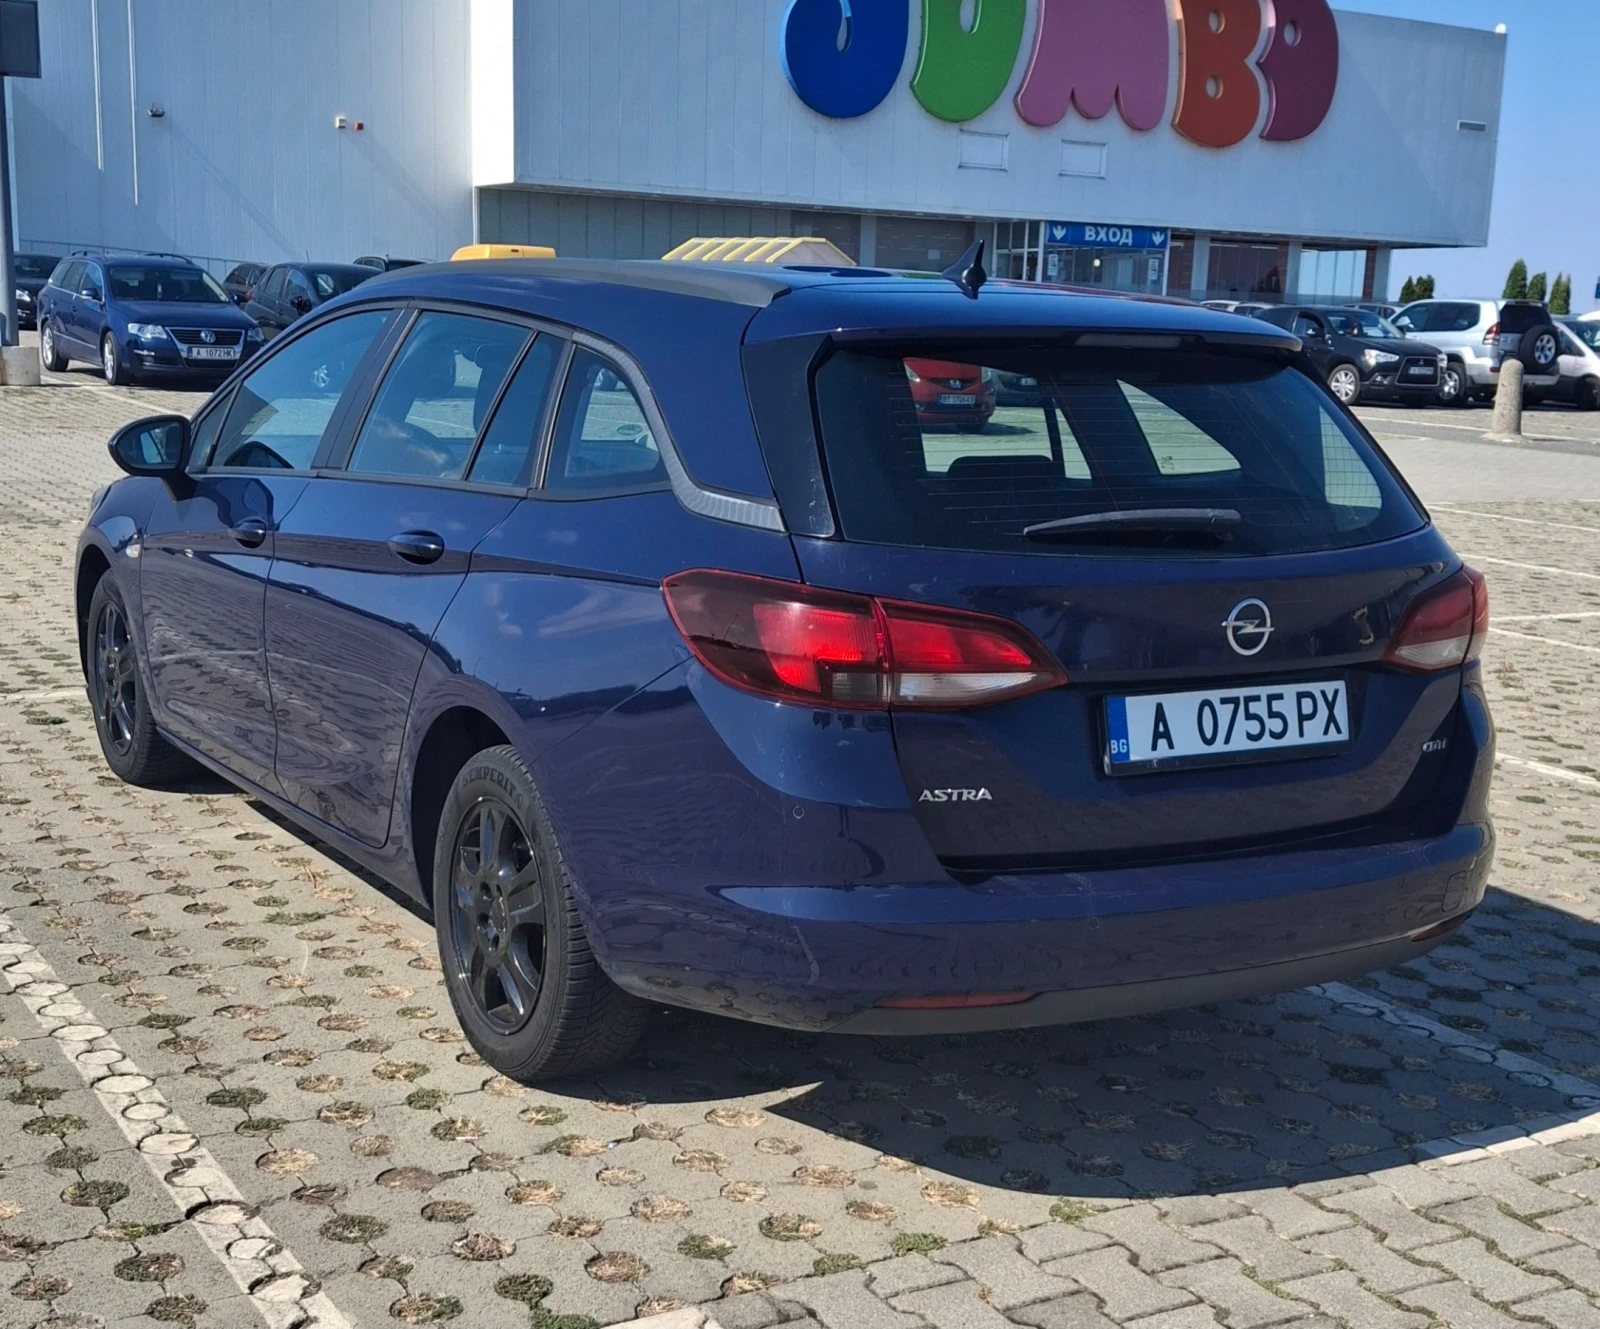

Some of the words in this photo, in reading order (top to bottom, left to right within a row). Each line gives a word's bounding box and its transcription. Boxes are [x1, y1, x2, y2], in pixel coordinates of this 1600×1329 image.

[1084, 226, 1133, 246] ВХОД
[1111, 739, 1128, 754] BG
[919, 787, 993, 802] ASTRA
